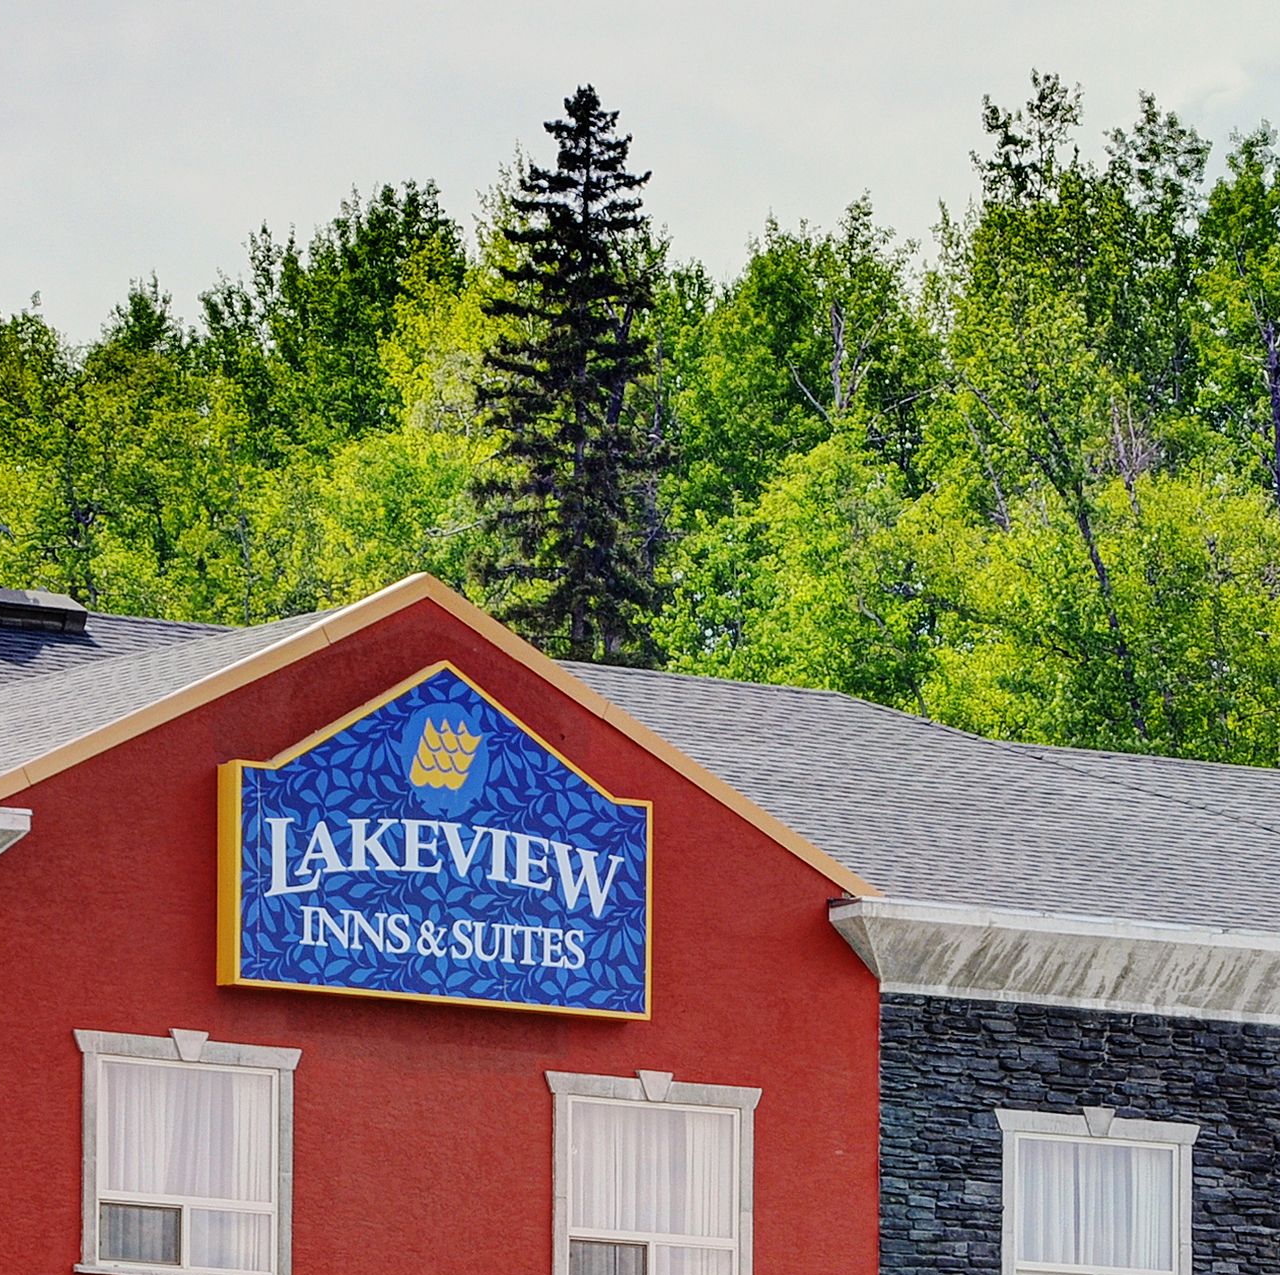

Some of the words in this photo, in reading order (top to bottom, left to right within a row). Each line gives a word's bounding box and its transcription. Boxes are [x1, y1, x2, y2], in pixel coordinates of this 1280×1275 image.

[264, 816, 624, 919] LAKEVIEW
[299, 905, 411, 954] INNS
[416, 920, 448, 957] &
[450, 920, 586, 970] SUITES
